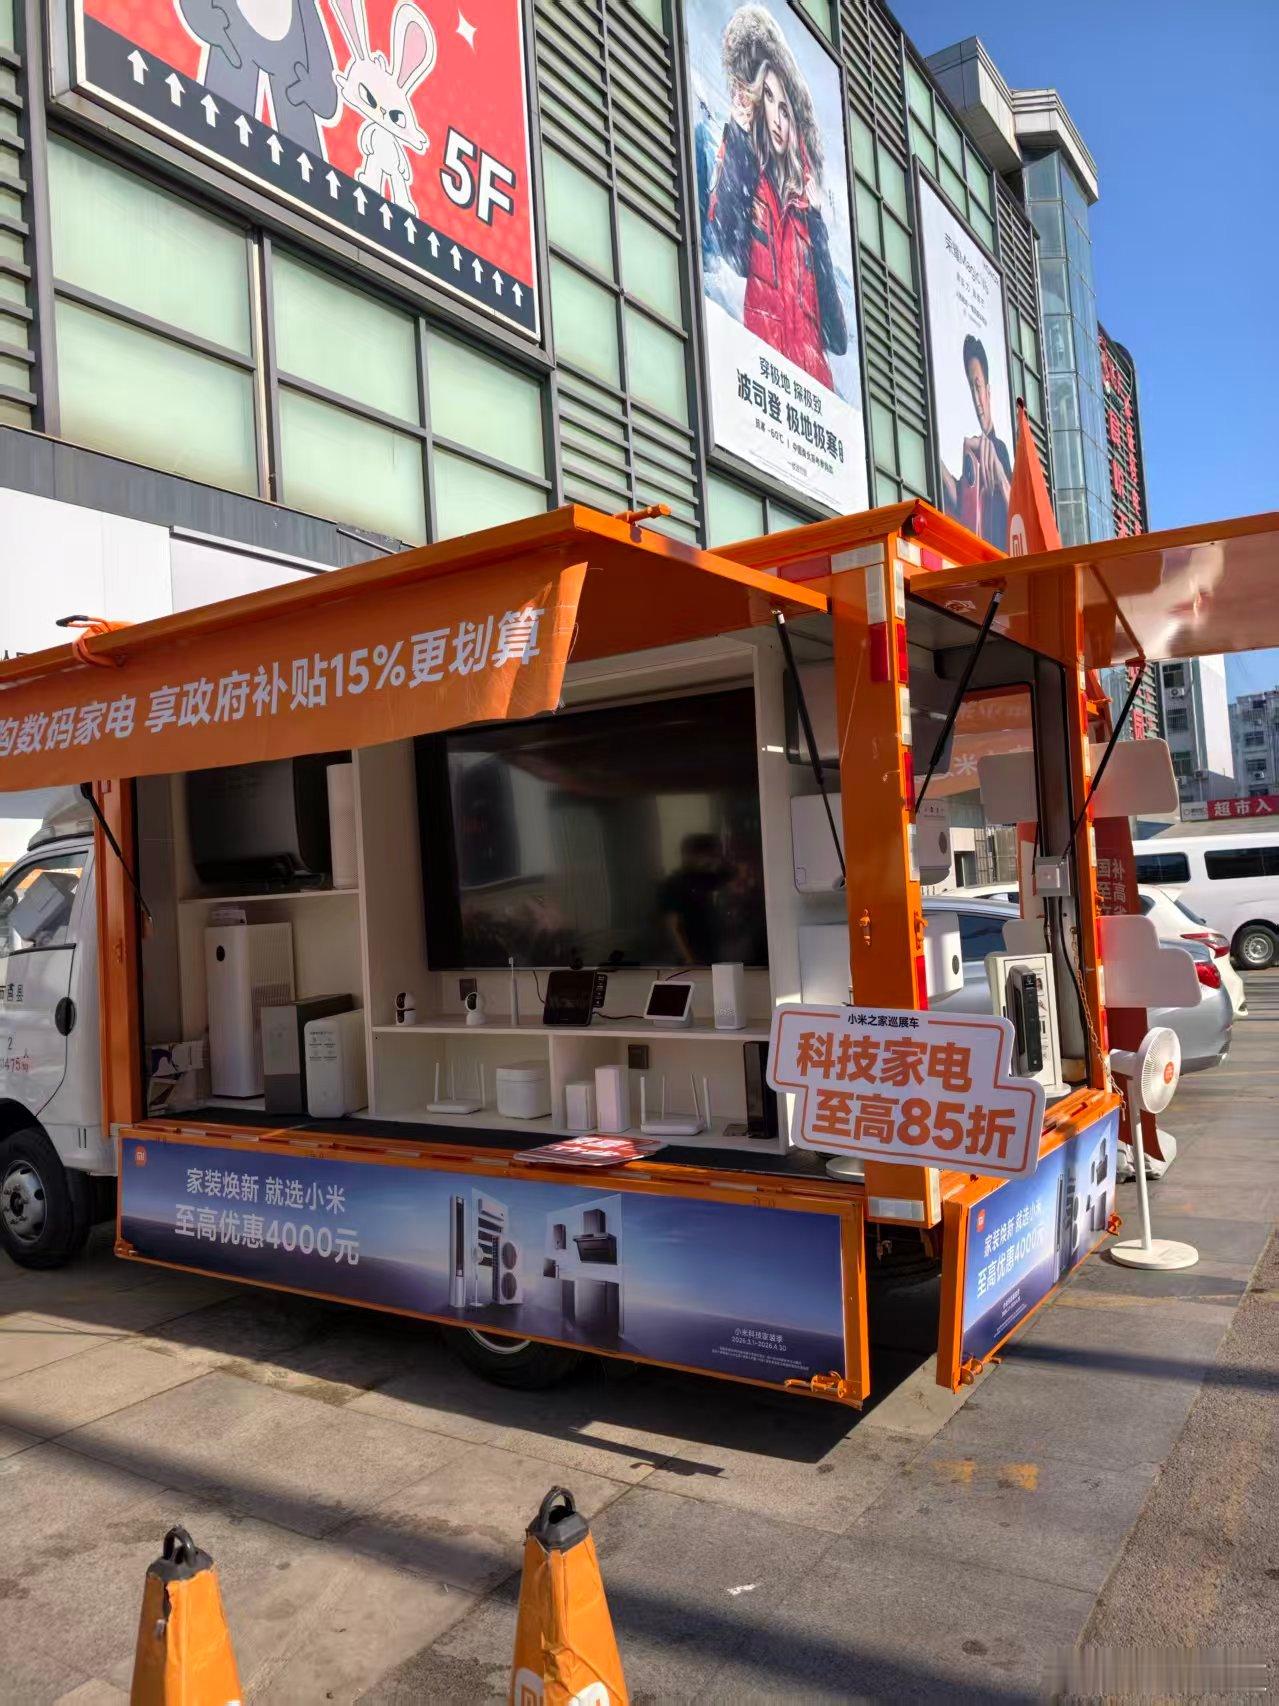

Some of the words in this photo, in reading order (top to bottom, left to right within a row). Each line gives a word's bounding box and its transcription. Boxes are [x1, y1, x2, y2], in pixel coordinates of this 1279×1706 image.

[440, 126, 514, 224] 5F
[736, 368, 782, 424] 波司登
[786, 402, 837, 460] 极地极寒
[759, 356, 791, 395] 穿极地
[793, 380, 822, 416] 探极致
[144, 607, 545, 733] 享政府补贴15%更划算
[847, 1013, 920, 1029] 小米之家巡展车
[796, 1031, 973, 1093] 科技家电
[811, 1088, 1016, 1159] 至高85折
[186, 1167, 260, 1204] 家装焕新
[265, 1177, 346, 1215] 就选小米
[174, 1203, 360, 1266] 至高优惠4000元
